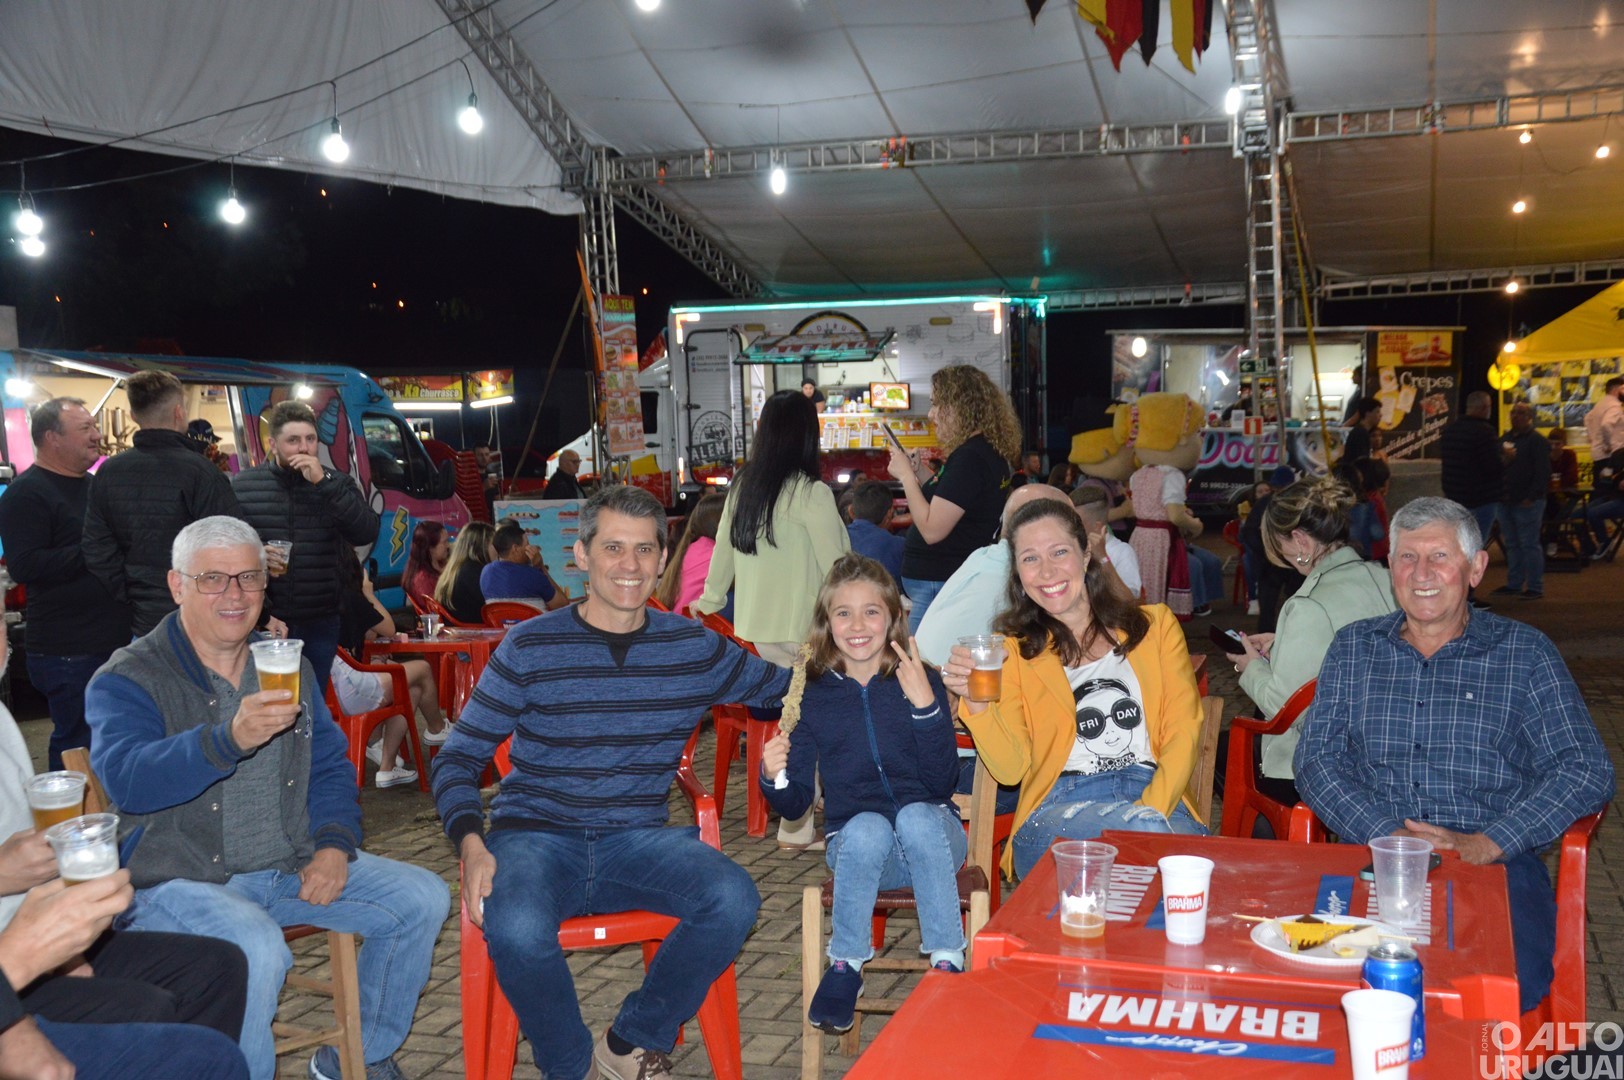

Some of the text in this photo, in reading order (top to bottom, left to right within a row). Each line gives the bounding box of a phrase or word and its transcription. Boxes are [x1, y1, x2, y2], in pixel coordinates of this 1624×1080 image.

[404, 384, 420, 398] Ka
[420, 388, 459, 398] Churrasco
[1400, 371, 1454, 393] Crepes
[1079, 707, 1138, 731] FRI DAY
[1168, 894, 1203, 911] BRAHMA
[1067, 991, 1320, 1042] BRAHMA
[1105, 1034, 1248, 1056] Chopp
